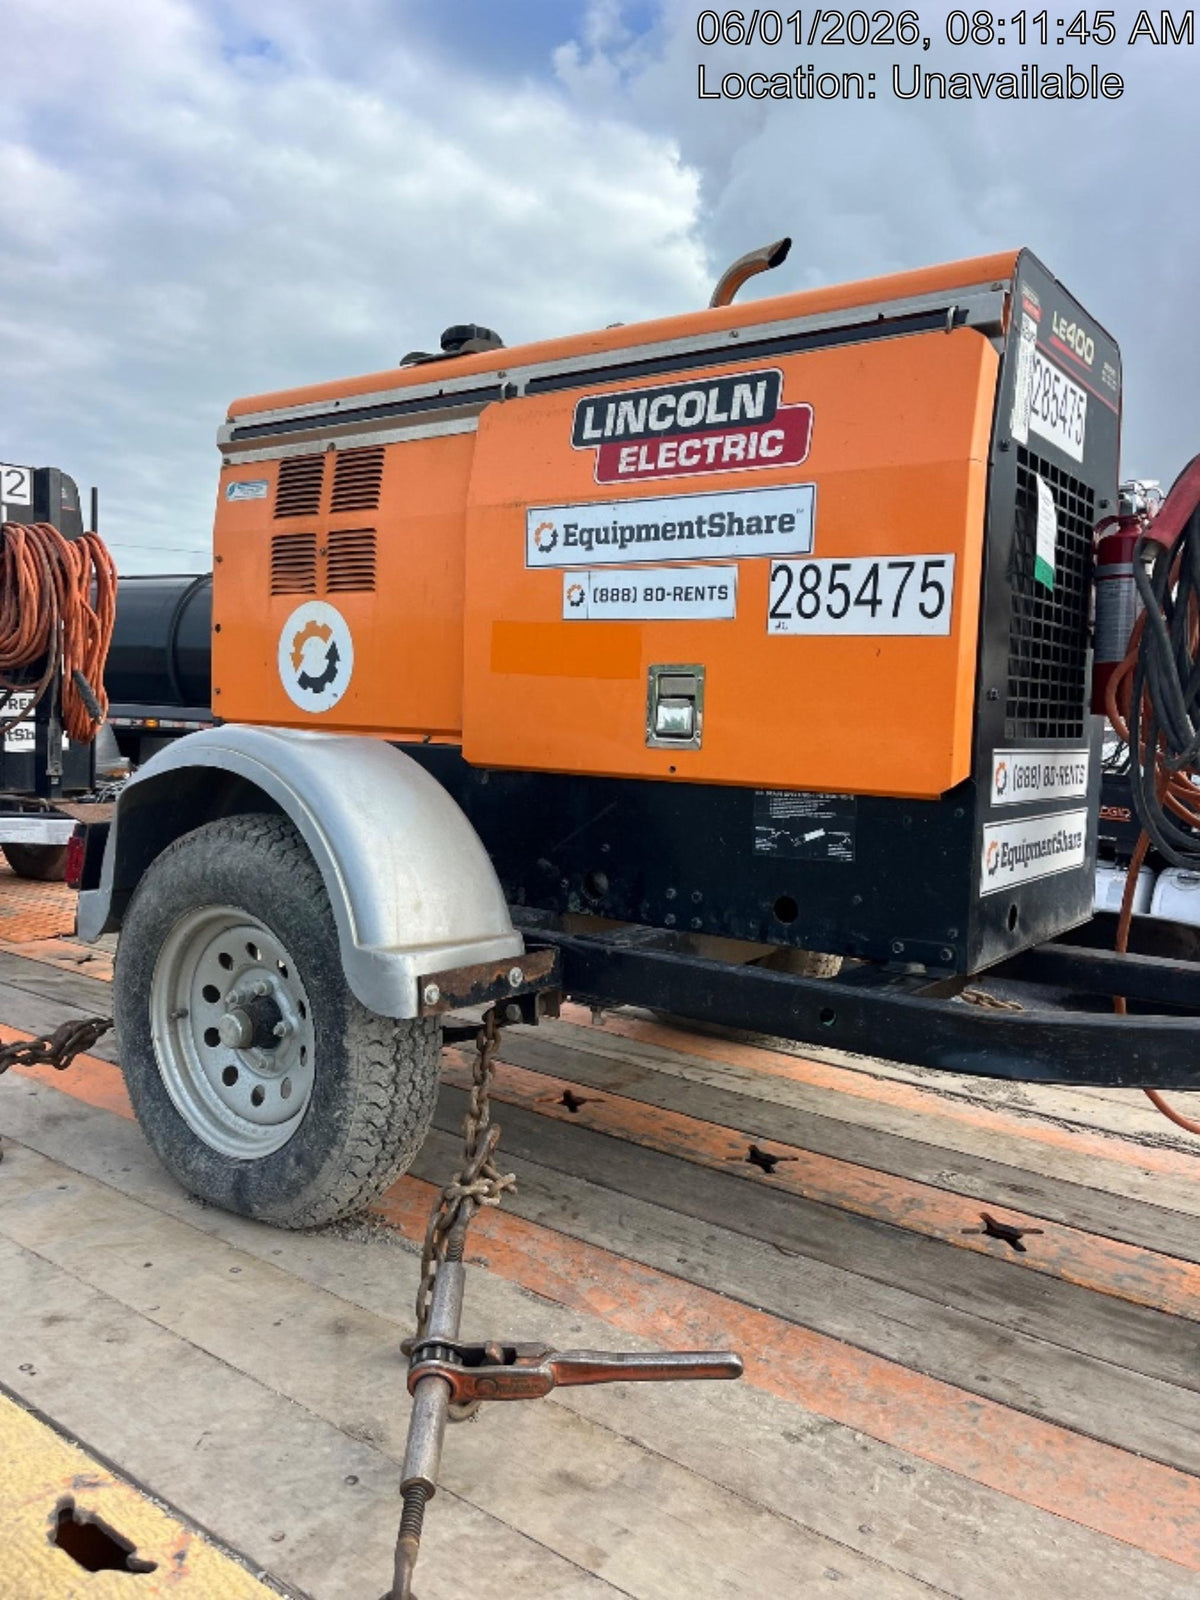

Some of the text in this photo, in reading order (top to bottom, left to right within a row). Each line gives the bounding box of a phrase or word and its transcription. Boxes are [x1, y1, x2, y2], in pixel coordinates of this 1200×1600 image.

[1052, 310, 1094, 365] LE400
[582, 380, 767, 440] LINCOLN
[1031, 358, 1084, 446] 285475
[618, 429, 785, 474] ELECTRIC
[563, 512, 796, 551] EquipmentShare
[593, 585, 729, 604] (888) 80-RENTS
[769, 560, 946, 619] 285475
[1001, 830, 1082, 871] EquipmentShare
